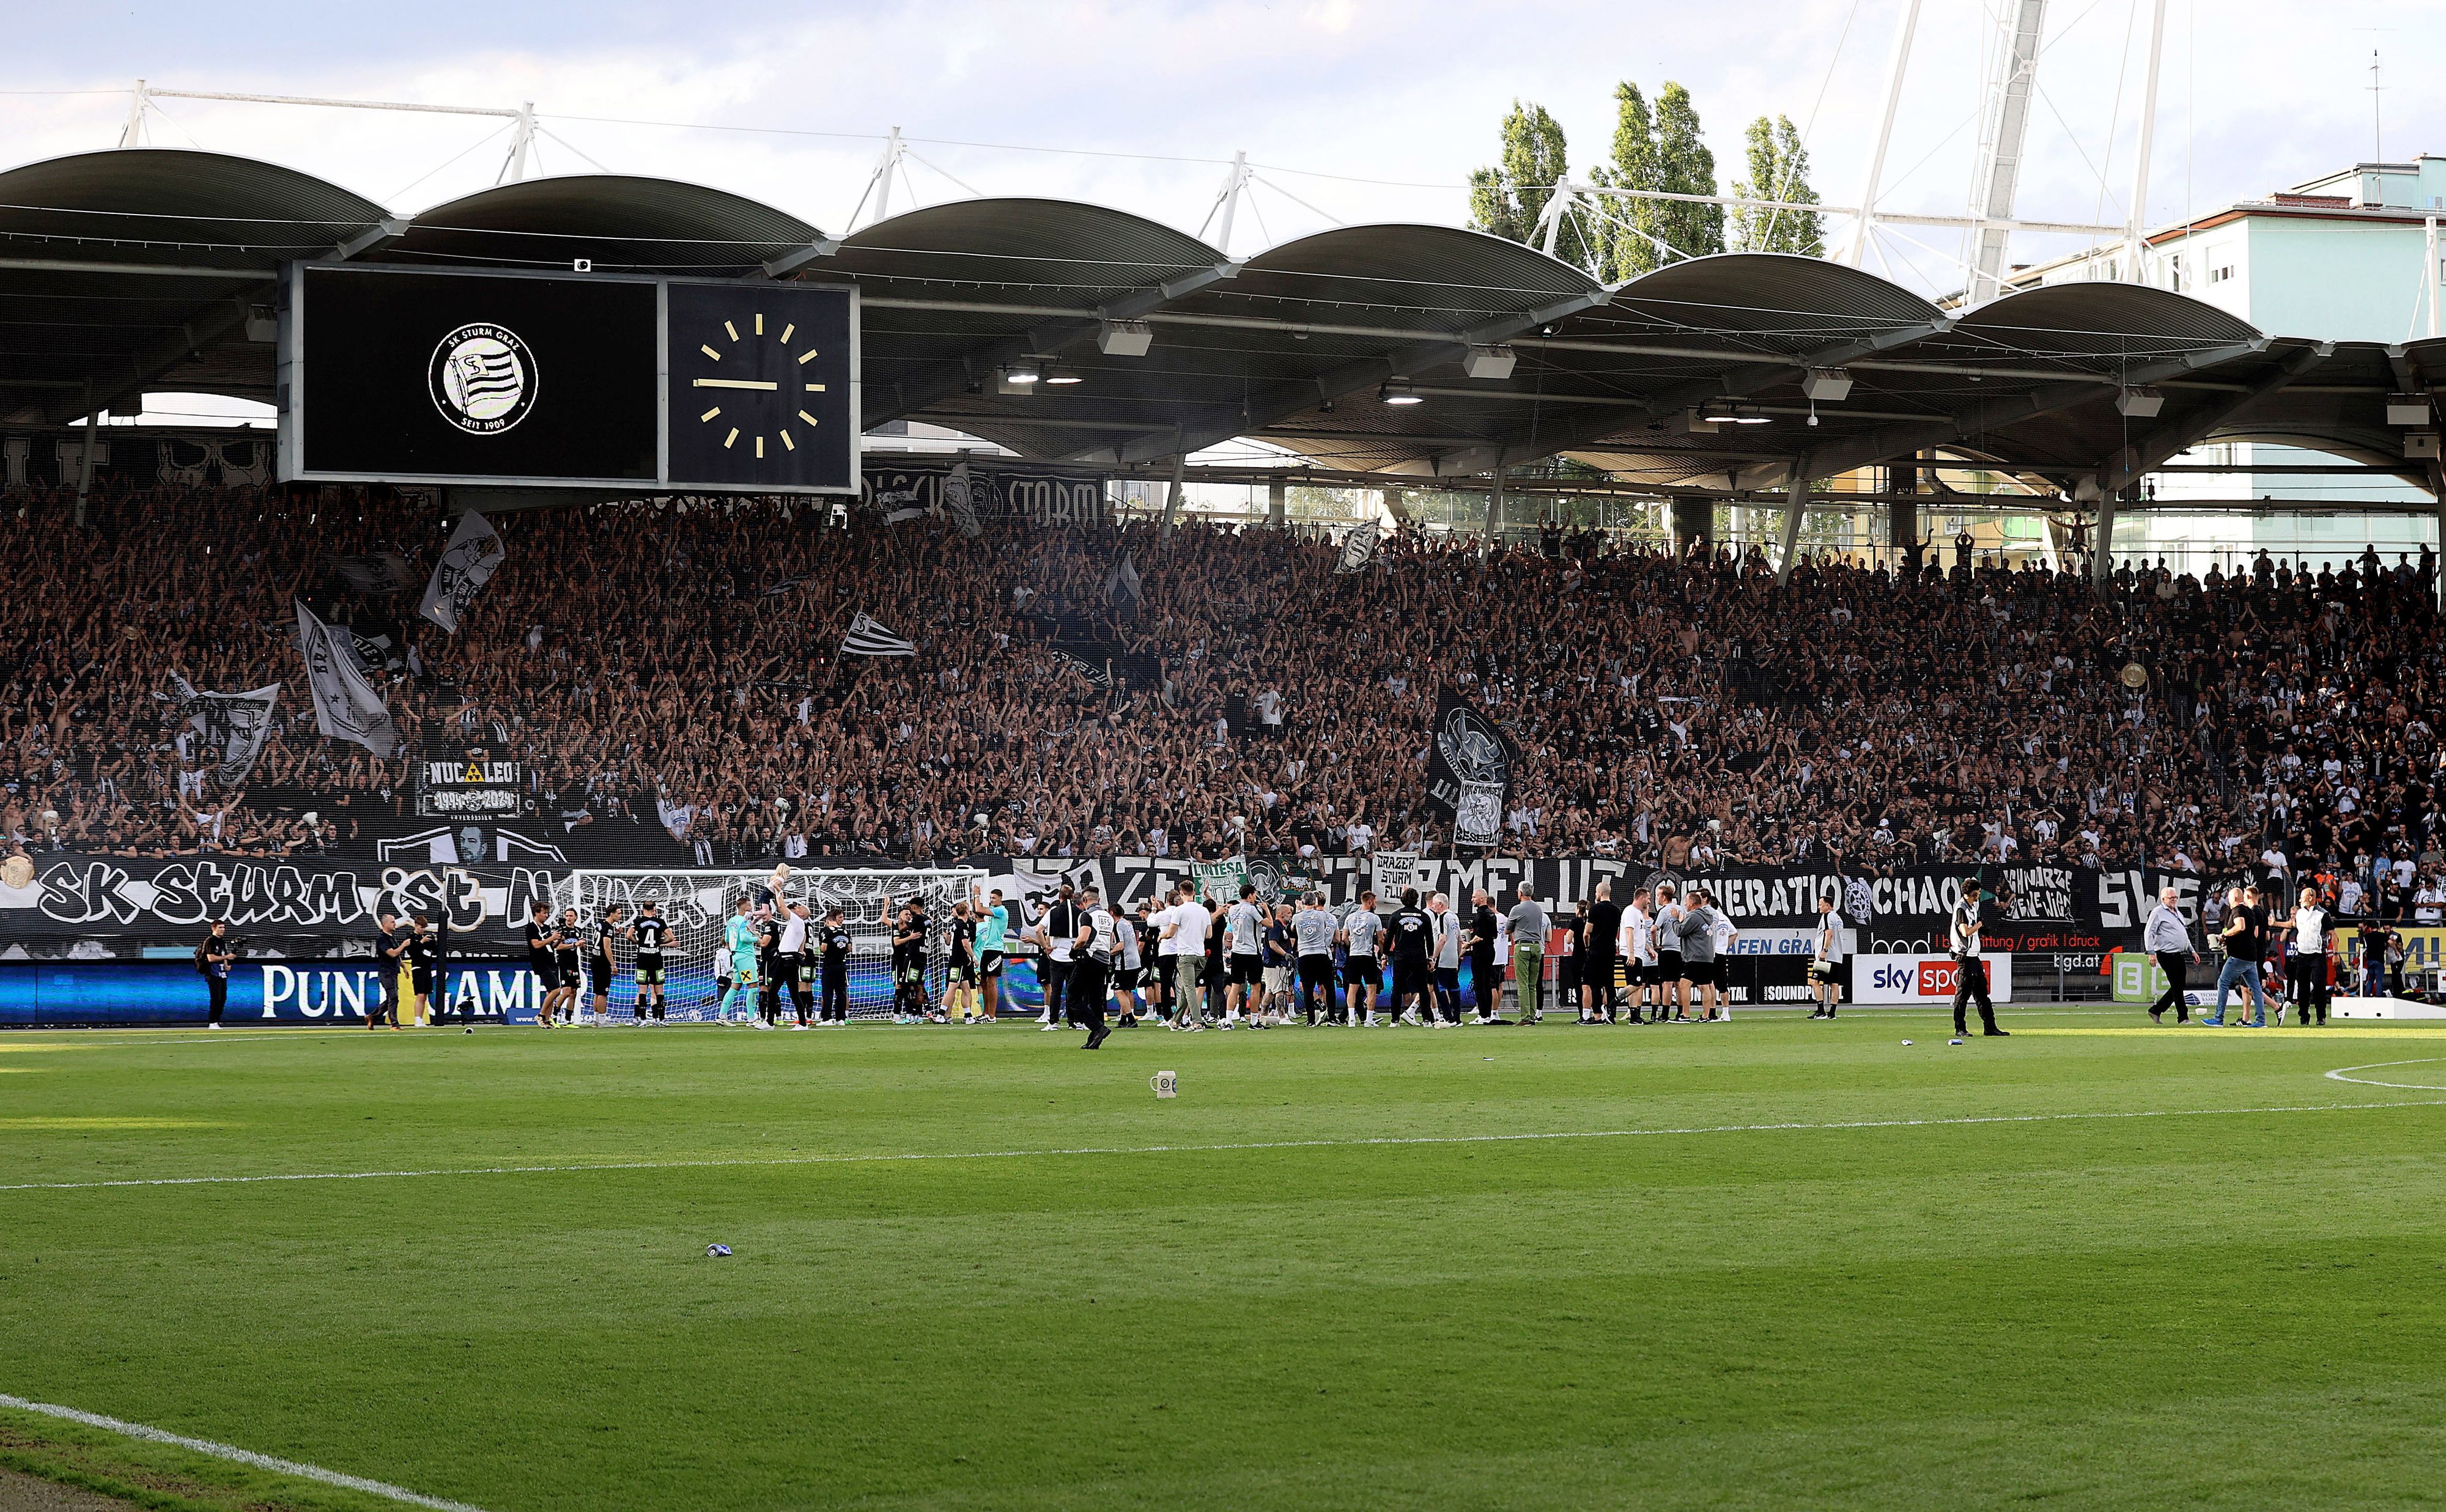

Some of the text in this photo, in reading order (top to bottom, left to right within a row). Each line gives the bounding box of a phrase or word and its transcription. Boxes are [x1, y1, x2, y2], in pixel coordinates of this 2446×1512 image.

[448, 328, 520, 350] SK STURM GRAZ
[461, 418, 505, 430] SEIT 1909
[1194, 861, 1244, 876] L'INTESA
[1377, 855, 1414, 869] GRAZER
[1381, 870, 1411, 885] STURM
[39, 862, 140, 925] SK
[1384, 885, 1403, 898] FLU
[1872, 876, 1972, 915] CHAO
[1100, 918, 1110, 926] BFS
[643, 928, 656, 948] 4
[1726, 939, 1815, 954] AFEN GRA
[989, 955, 1002, 968] STURM
[2053, 954, 2100, 972] bgd.at
[1873, 964, 1914, 994] sky
